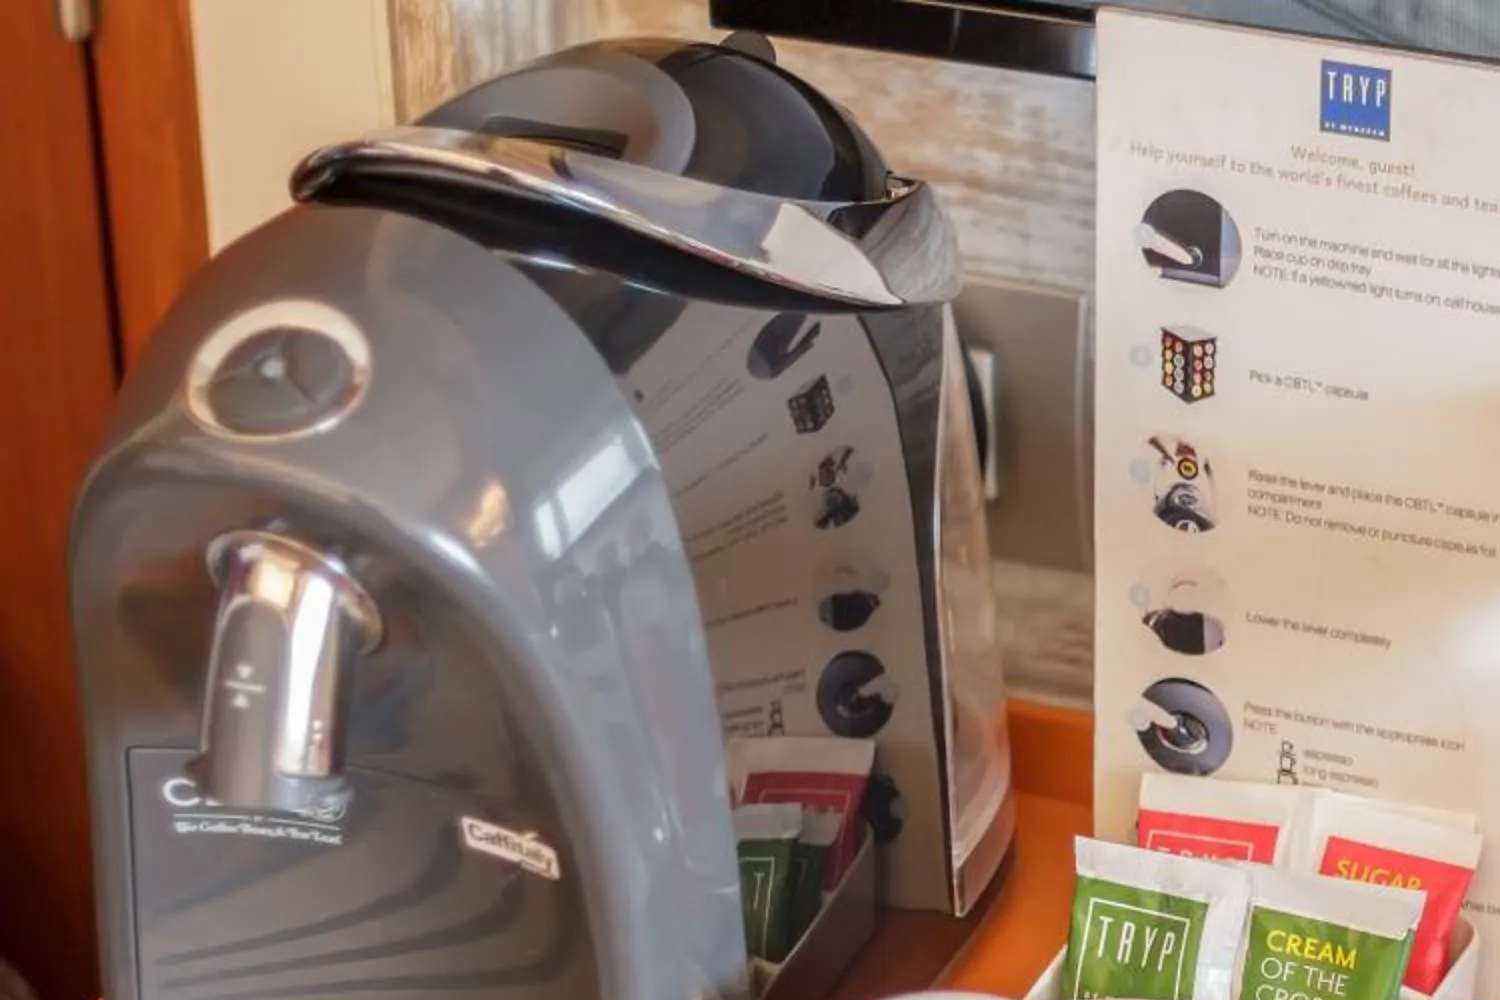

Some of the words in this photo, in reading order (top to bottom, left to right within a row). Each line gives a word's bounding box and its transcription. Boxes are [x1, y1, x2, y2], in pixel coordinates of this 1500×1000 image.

[1327, 71, 1386, 107] TRYP
[1129, 142, 1164, 162] Help
[1168, 149, 1226, 169] yourself
[1230, 159, 1246, 174] to
[1250, 160, 1275, 178] the
[1278, 165, 1332, 187] world's
[1337, 173, 1378, 195] finest
[1383, 182, 1437, 204] coffees
[1441, 193, 1469, 209] and
[1369, 159, 1415, 177] guest!
[1254, 227, 1281, 243] Turn
[1282, 232, 1299, 245] on
[1299, 234, 1318, 249] the
[1320, 239, 1369, 257] machine
[1371, 249, 1393, 262] and
[1452, 259, 1470, 273] the
[1254, 245, 1284, 261] Place
[1286, 251, 1308, 267] cup
[1309, 257, 1326, 268] on
[1097, 915, 1176, 972] TRYP
[1266, 929, 1357, 969] CREAM
[1261, 957, 1298, 982] OF
[1302, 965, 1350, 997] THE
